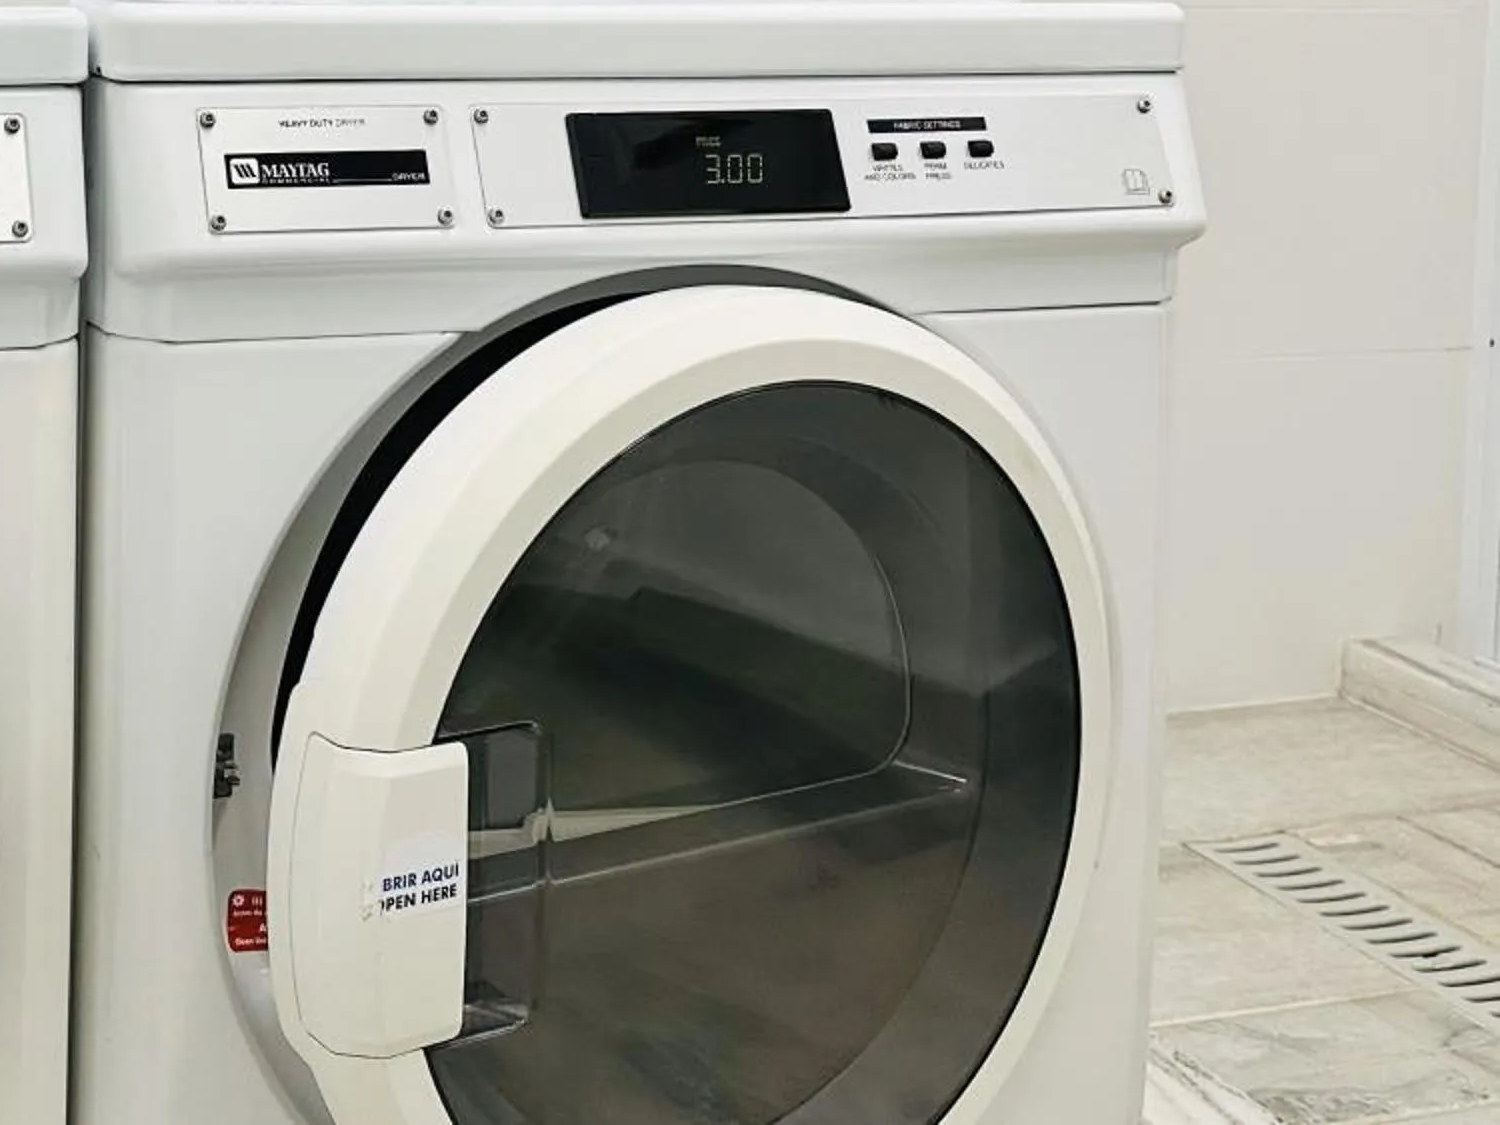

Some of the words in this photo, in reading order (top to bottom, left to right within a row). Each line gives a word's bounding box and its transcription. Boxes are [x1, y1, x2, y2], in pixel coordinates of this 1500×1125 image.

[261, 162, 330, 179] MAYTAG
[705, 154, 764, 185] 3.00
[382, 873, 417, 893] BRIR
[420, 883, 458, 904] HERE
